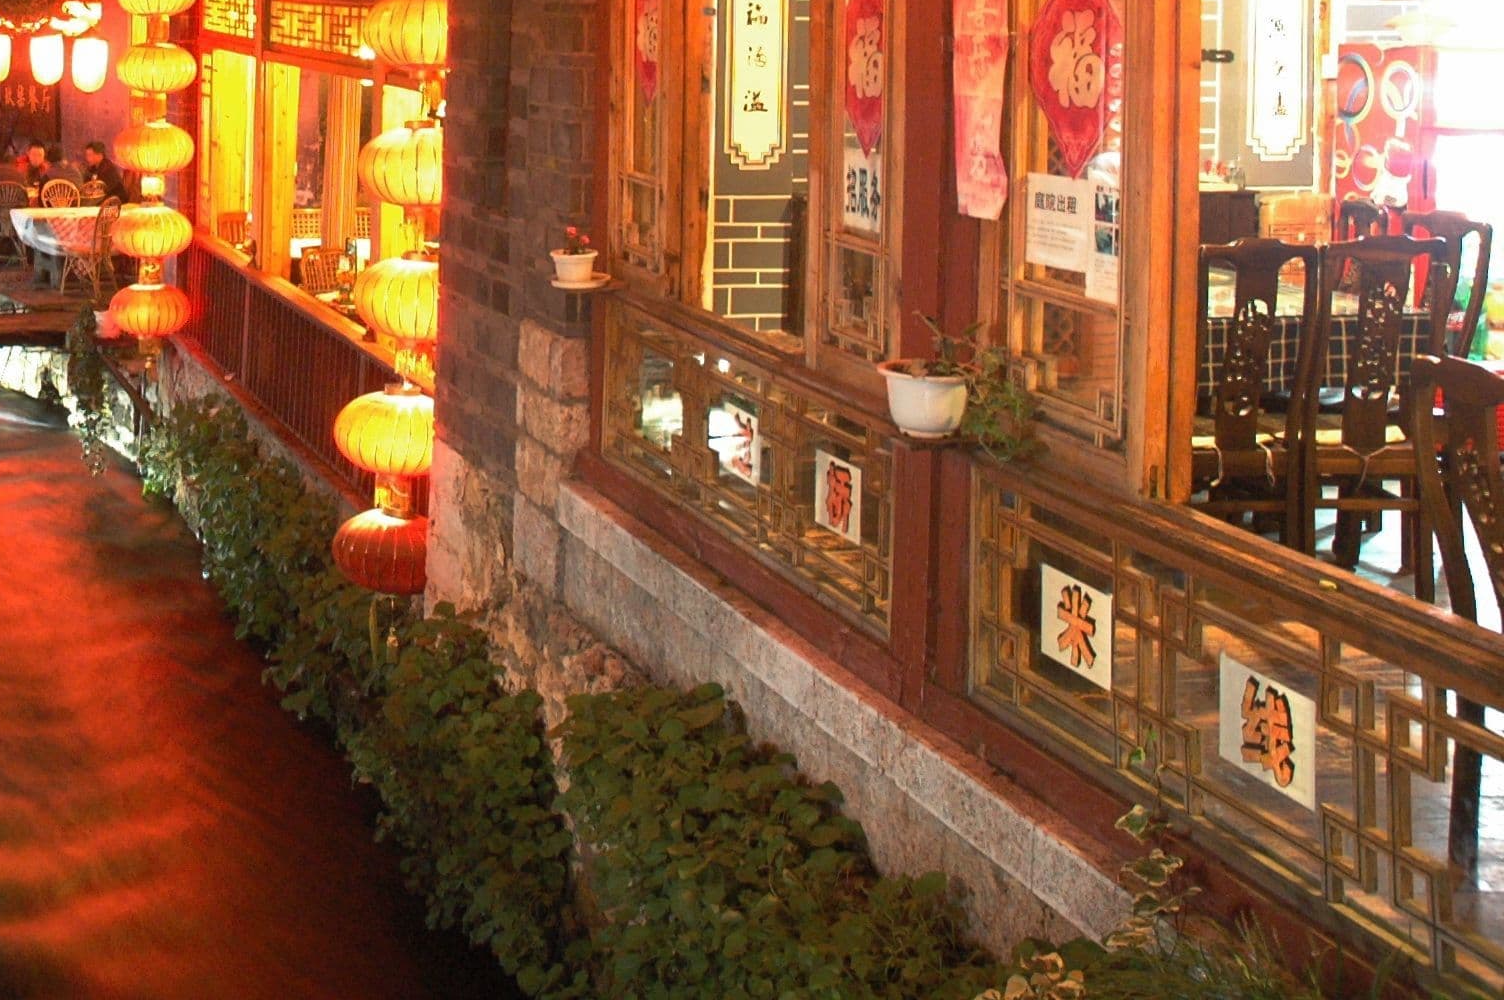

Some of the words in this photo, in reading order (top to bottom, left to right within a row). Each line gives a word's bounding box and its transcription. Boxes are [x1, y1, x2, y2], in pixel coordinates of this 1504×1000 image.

[848, 17, 883, 99] 福
[1049, 9, 1105, 108] 福
[827, 460, 852, 534] 桥
[1057, 584, 1097, 669] 米
[1241, 676, 1295, 788] 线
